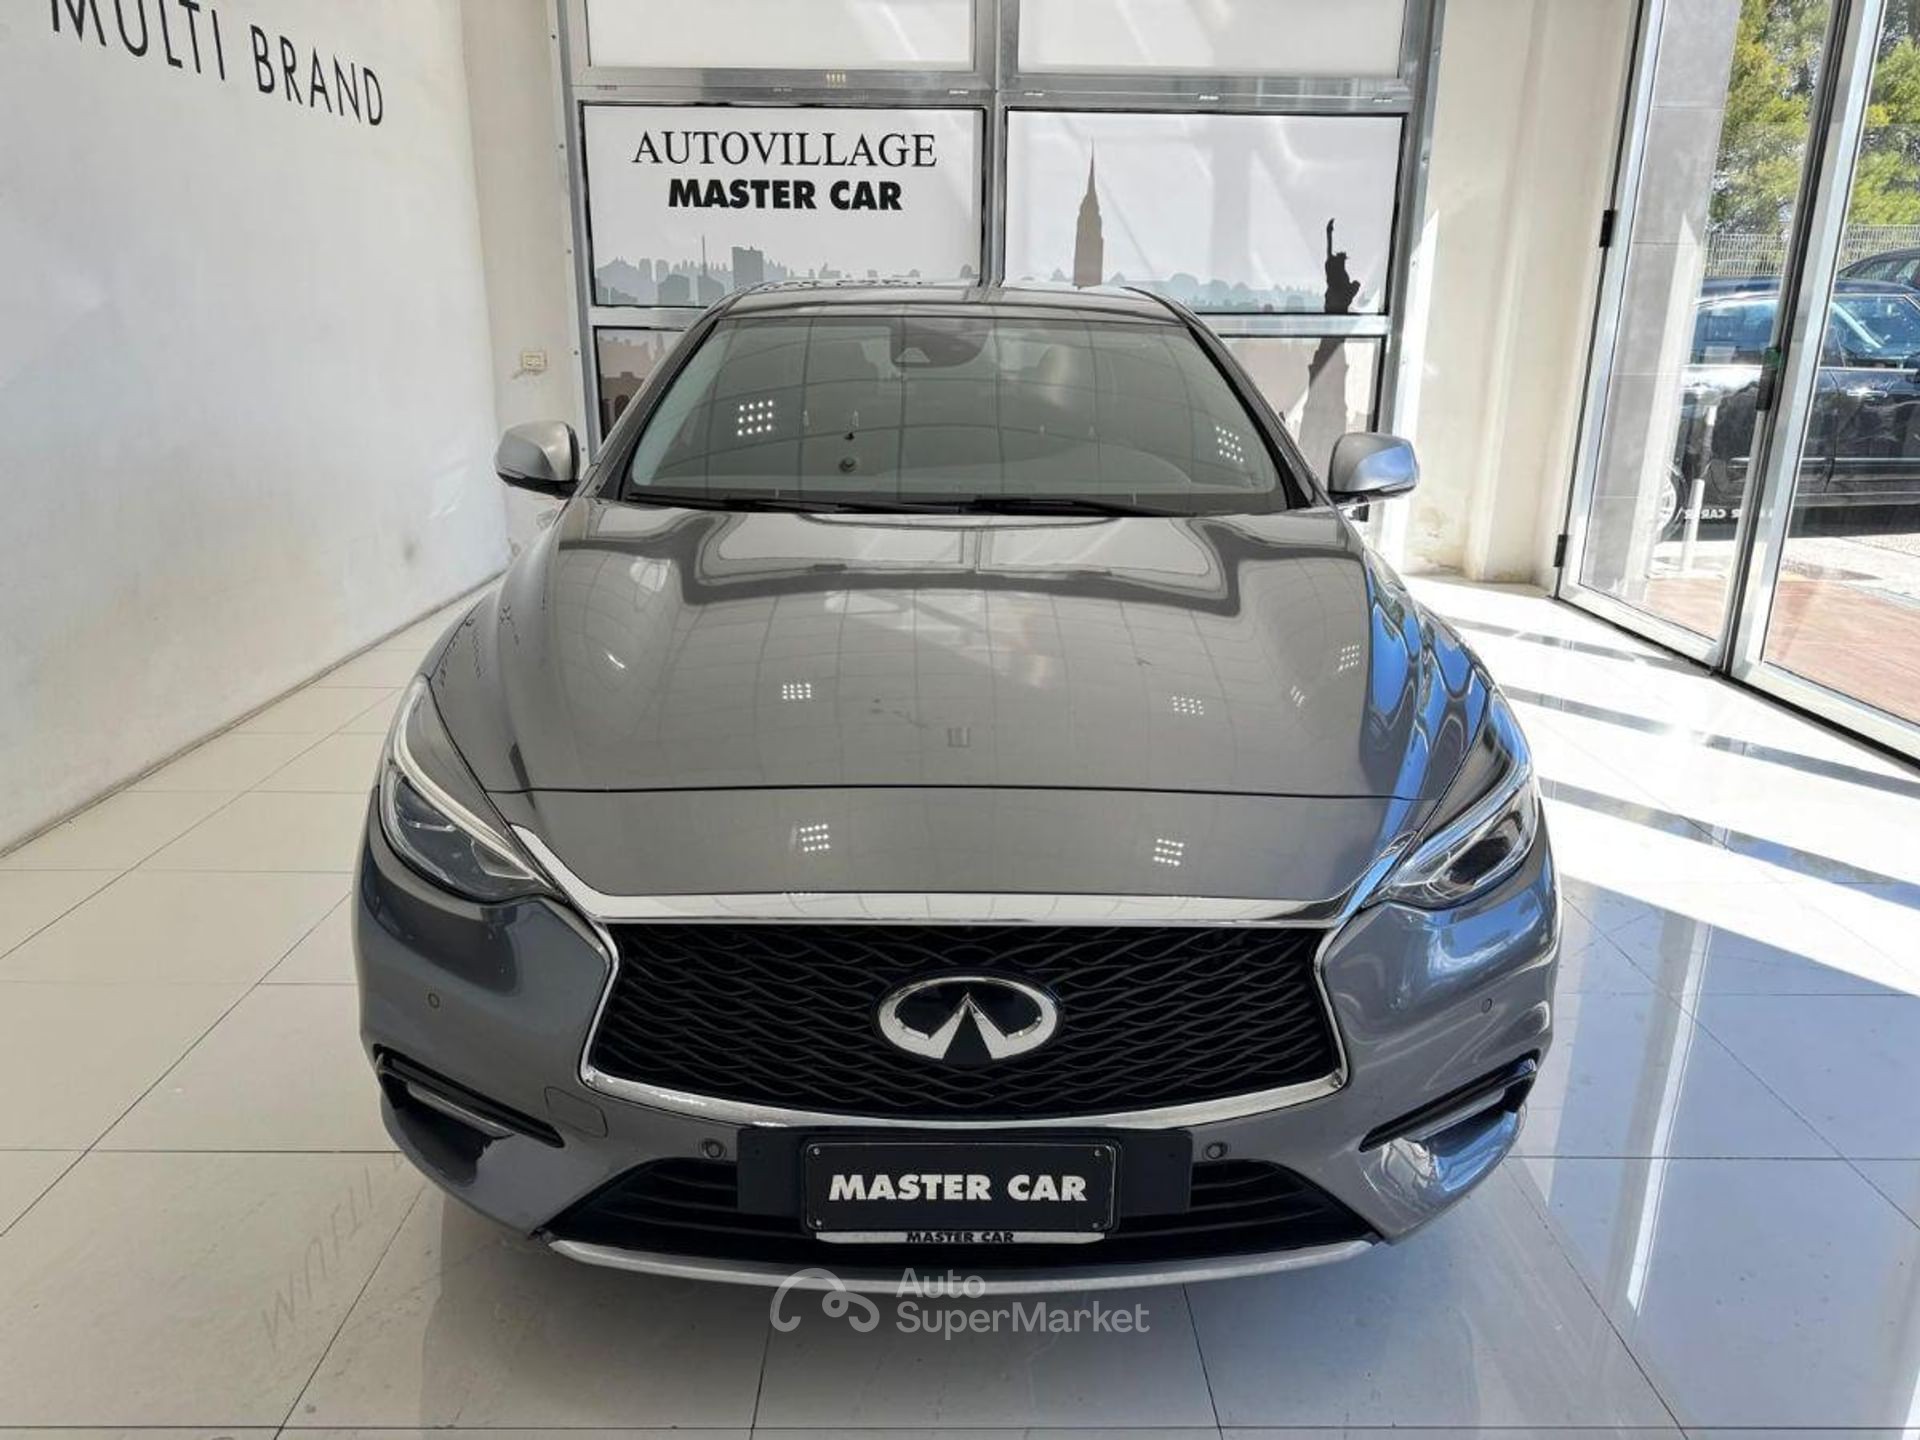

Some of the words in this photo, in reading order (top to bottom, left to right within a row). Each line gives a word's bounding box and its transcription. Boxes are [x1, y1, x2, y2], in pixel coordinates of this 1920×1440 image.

[250, 24, 383, 126] BRAND
[631, 130, 938, 168] AUTOVILLAGE
[668, 178, 817, 210] MASTER
[829, 181, 903, 210] CAR
[828, 1173, 992, 1201] MASTER
[1007, 1174, 1088, 1201] CAR
[905, 1231, 975, 1243] MASTER
[980, 1231, 1015, 1243] CAR
